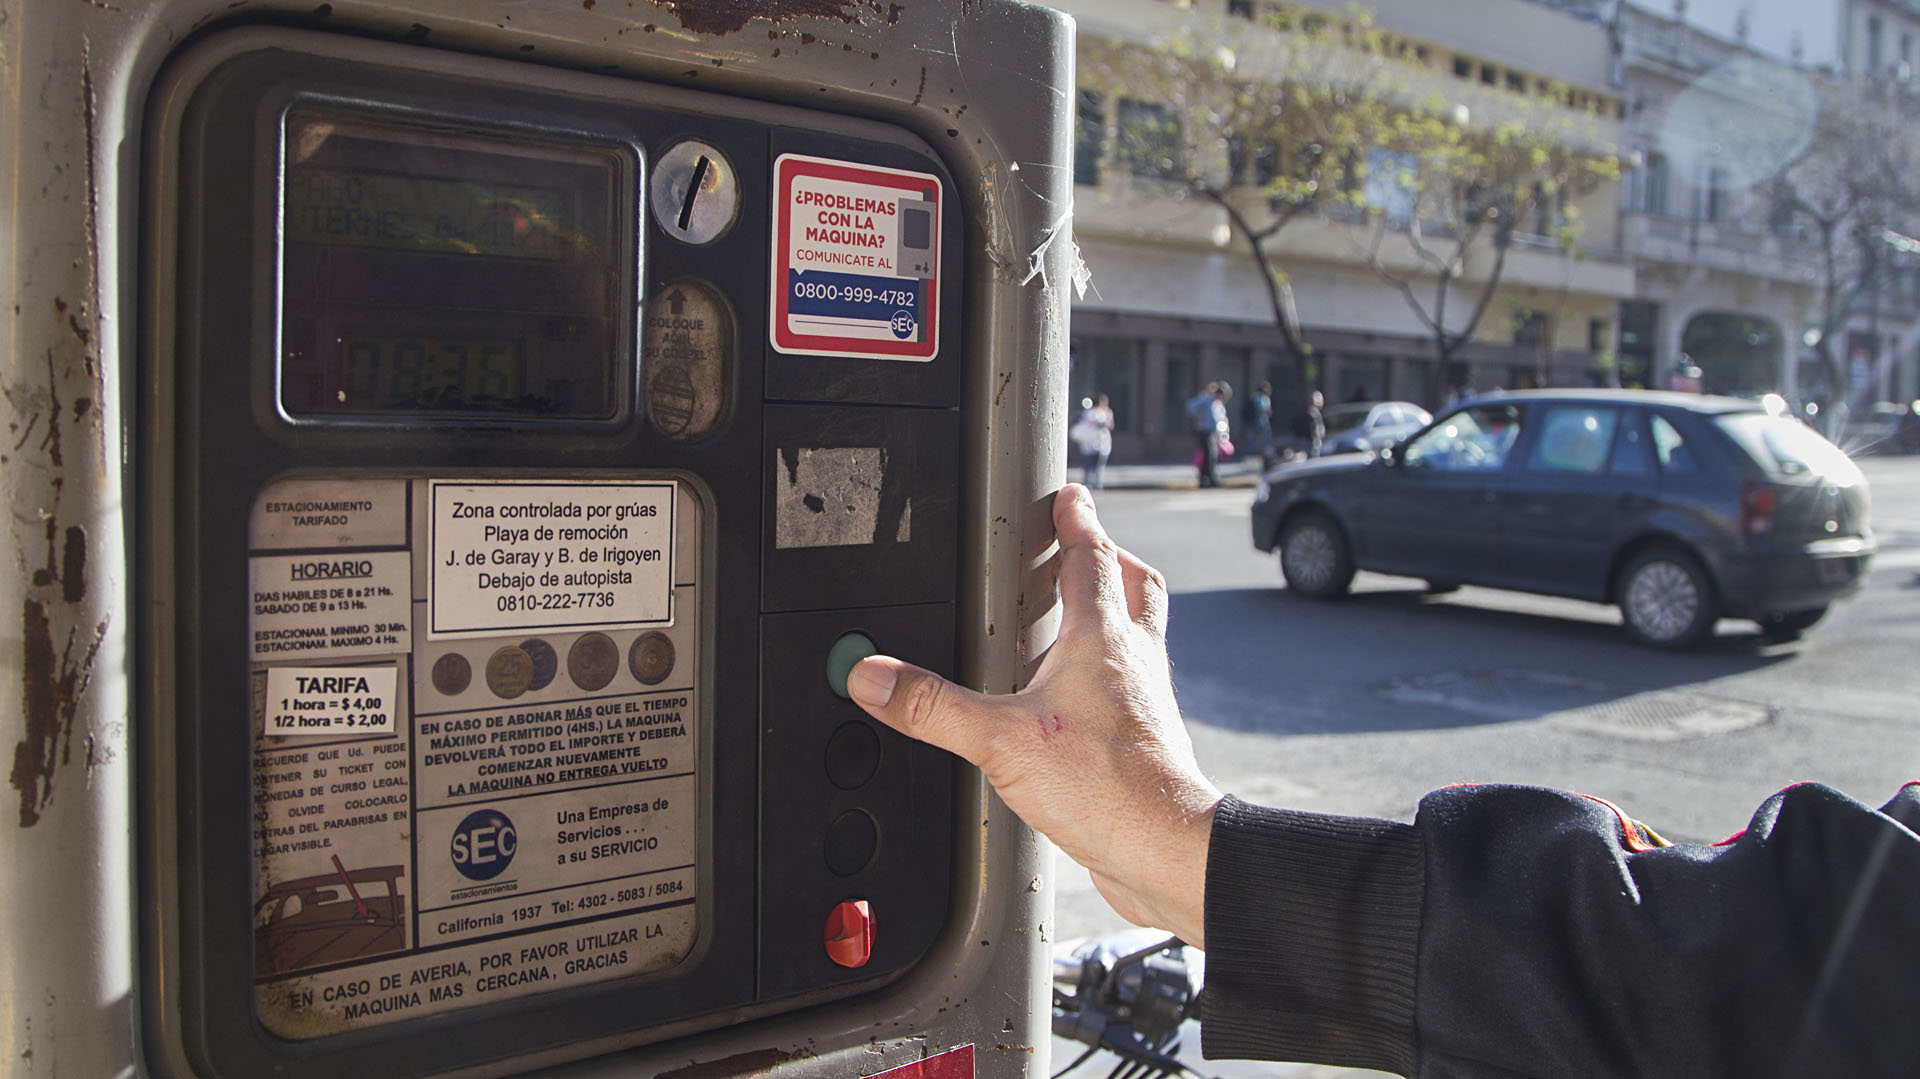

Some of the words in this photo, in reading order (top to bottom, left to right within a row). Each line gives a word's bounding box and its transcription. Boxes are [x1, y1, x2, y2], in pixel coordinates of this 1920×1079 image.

[795, 190, 896, 215] ¿PROBLEMAS
[818, 211, 850, 228] CON
[855, 215, 875, 230] LA
[806, 227, 885, 248] MAQUINA?
[796, 249, 874, 267] COMUNICATE
[878, 258, 892, 269] AL
[794, 282, 915, 307] 0800-999-4782
[892, 317, 914, 332] SEC
[266, 501, 373, 513] ESTACIONAMIENTO
[452, 502, 495, 519] Zona
[499, 502, 582, 518] controlada
[587, 505, 612, 521] por
[616, 501, 657, 521] grúas
[292, 515, 348, 526] TARIFADO
[484, 525, 529, 545] Playa
[534, 525, 554, 541] de
[558, 524, 628, 541] remoción
[446, 550, 460, 567] J.
[465, 550, 486, 566] de
[491, 549, 540, 568] Garay
[545, 552, 554, 567] y
[558, 548, 574, 563] B.
[579, 548, 598, 563] de
[603, 546, 661, 565] Irigoyen
[291, 560, 373, 579] HORARIO
[478, 572, 535, 591] Debajo
[540, 571, 559, 587] de
[564, 570, 632, 588] autopista
[254, 592, 279, 603] DIAS
[282, 589, 327, 601] HABILES
[330, 589, 345, 599] DE
[346, 588, 353, 598] 8
[364, 588, 375, 597] 21
[377, 587, 394, 596] Hs.
[497, 592, 615, 612] 0810-222-7736
[255, 603, 299, 615] SABADO
[302, 602, 318, 613] DE
[319, 601, 326, 611] 9
[329, 603, 335, 611] a
[338, 601, 349, 610] 13
[352, 600, 367, 610] Hs.
[255, 628, 328, 641] ESTACIONAM.
[331, 624, 369, 635] MINIMO
[374, 623, 386, 633] 30
[255, 640, 328, 653] ESTACIONAM.
[331, 636, 373, 648] MAXIMO
[375, 636, 381, 645] 4
[383, 635, 399, 644] Hs.
[296, 677, 369, 694] TARIFA
[281, 699, 289, 710] 1
[293, 698, 325, 711] hora
[342, 697, 350, 711] $
[353, 698, 381, 711] 4,00
[274, 715, 294, 728] 1/2
[298, 715, 330, 727] hora
[347, 714, 355, 727] $
[359, 714, 386, 727] 2,00
[421, 722, 440, 735] EN
[443, 718, 482, 733] CASO
[485, 716, 504, 730] DE
[507, 710, 562, 728] ABONAR
[564, 705, 593, 722] MÁS
[595, 704, 622, 718] QUE
[625, 702, 640, 714] EL
[643, 697, 688, 712] TIEMPO
[430, 732, 487, 750] MÁXIMO
[491, 725, 563, 744] PERMITIDO
[567, 721, 603, 737] (4HS.)
[607, 717, 623, 730] LA
[626, 712, 682, 728] MAQUINA
[318, 750, 339, 761] QUE
[348, 748, 364, 757] Ud.
[373, 743, 406, 755] PUEDE
[424, 744, 506, 766] DEVOLVERÁ
[510, 742, 546, 757] TODO
[549, 739, 565, 751] EL
[568, 733, 624, 749] IMPORTE
[627, 731, 636, 742] Y
[639, 723, 687, 741] DEBERÁ
[313, 768, 327, 779] SU
[339, 763, 374, 776] TICKET
[385, 760, 406, 770] CON
[478, 757, 552, 777] COMENZAR
[556, 747, 641, 766] NUEVAMENTE
[448, 784, 465, 797] LA
[469, 775, 532, 794] MAQUINA
[536, 772, 555, 784] NO
[559, 764, 618, 782] ENTREGA
[621, 758, 668, 774] VUELTO
[310, 786, 324, 796] DE
[330, 781, 366, 794] CURSO
[288, 805, 324, 818] OLVIDE
[345, 794, 407, 810] COLOCARLO
[557, 810, 585, 825] Una
[589, 800, 649, 820] Empresa
[652, 798, 669, 811] de
[299, 823, 319, 834] DEL
[324, 812, 388, 831] PARABRISAS
[393, 811, 407, 821] EN
[557, 824, 621, 844] Servicios
[451, 826, 517, 865] SEC
[557, 854, 566, 864] a
[570, 850, 587, 862] su
[591, 836, 658, 859] SERVICIO
[451, 883, 518, 901] estacionamientos
[437, 913, 504, 935] California
[512, 905, 542, 922] 1937
[552, 900, 574, 914] Tel:
[578, 893, 607, 910] 4302
[617, 887, 645, 903] 5083
[655, 880, 683, 896] 5084
[290, 991, 313, 1009] EN
[323, 980, 371, 1002] CASO
[380, 974, 401, 991] DE
[409, 961, 471, 985] AVERIA,
[480, 953, 512, 971] POR
[520, 942, 569, 964] FAVOR
[576, 928, 638, 952] UTILIZAR
[646, 924, 663, 939] LA
[344, 992, 421, 1020] MAQUINA
[429, 983, 463, 1002] MAS
[565, 950, 628, 975] GRACIAS
